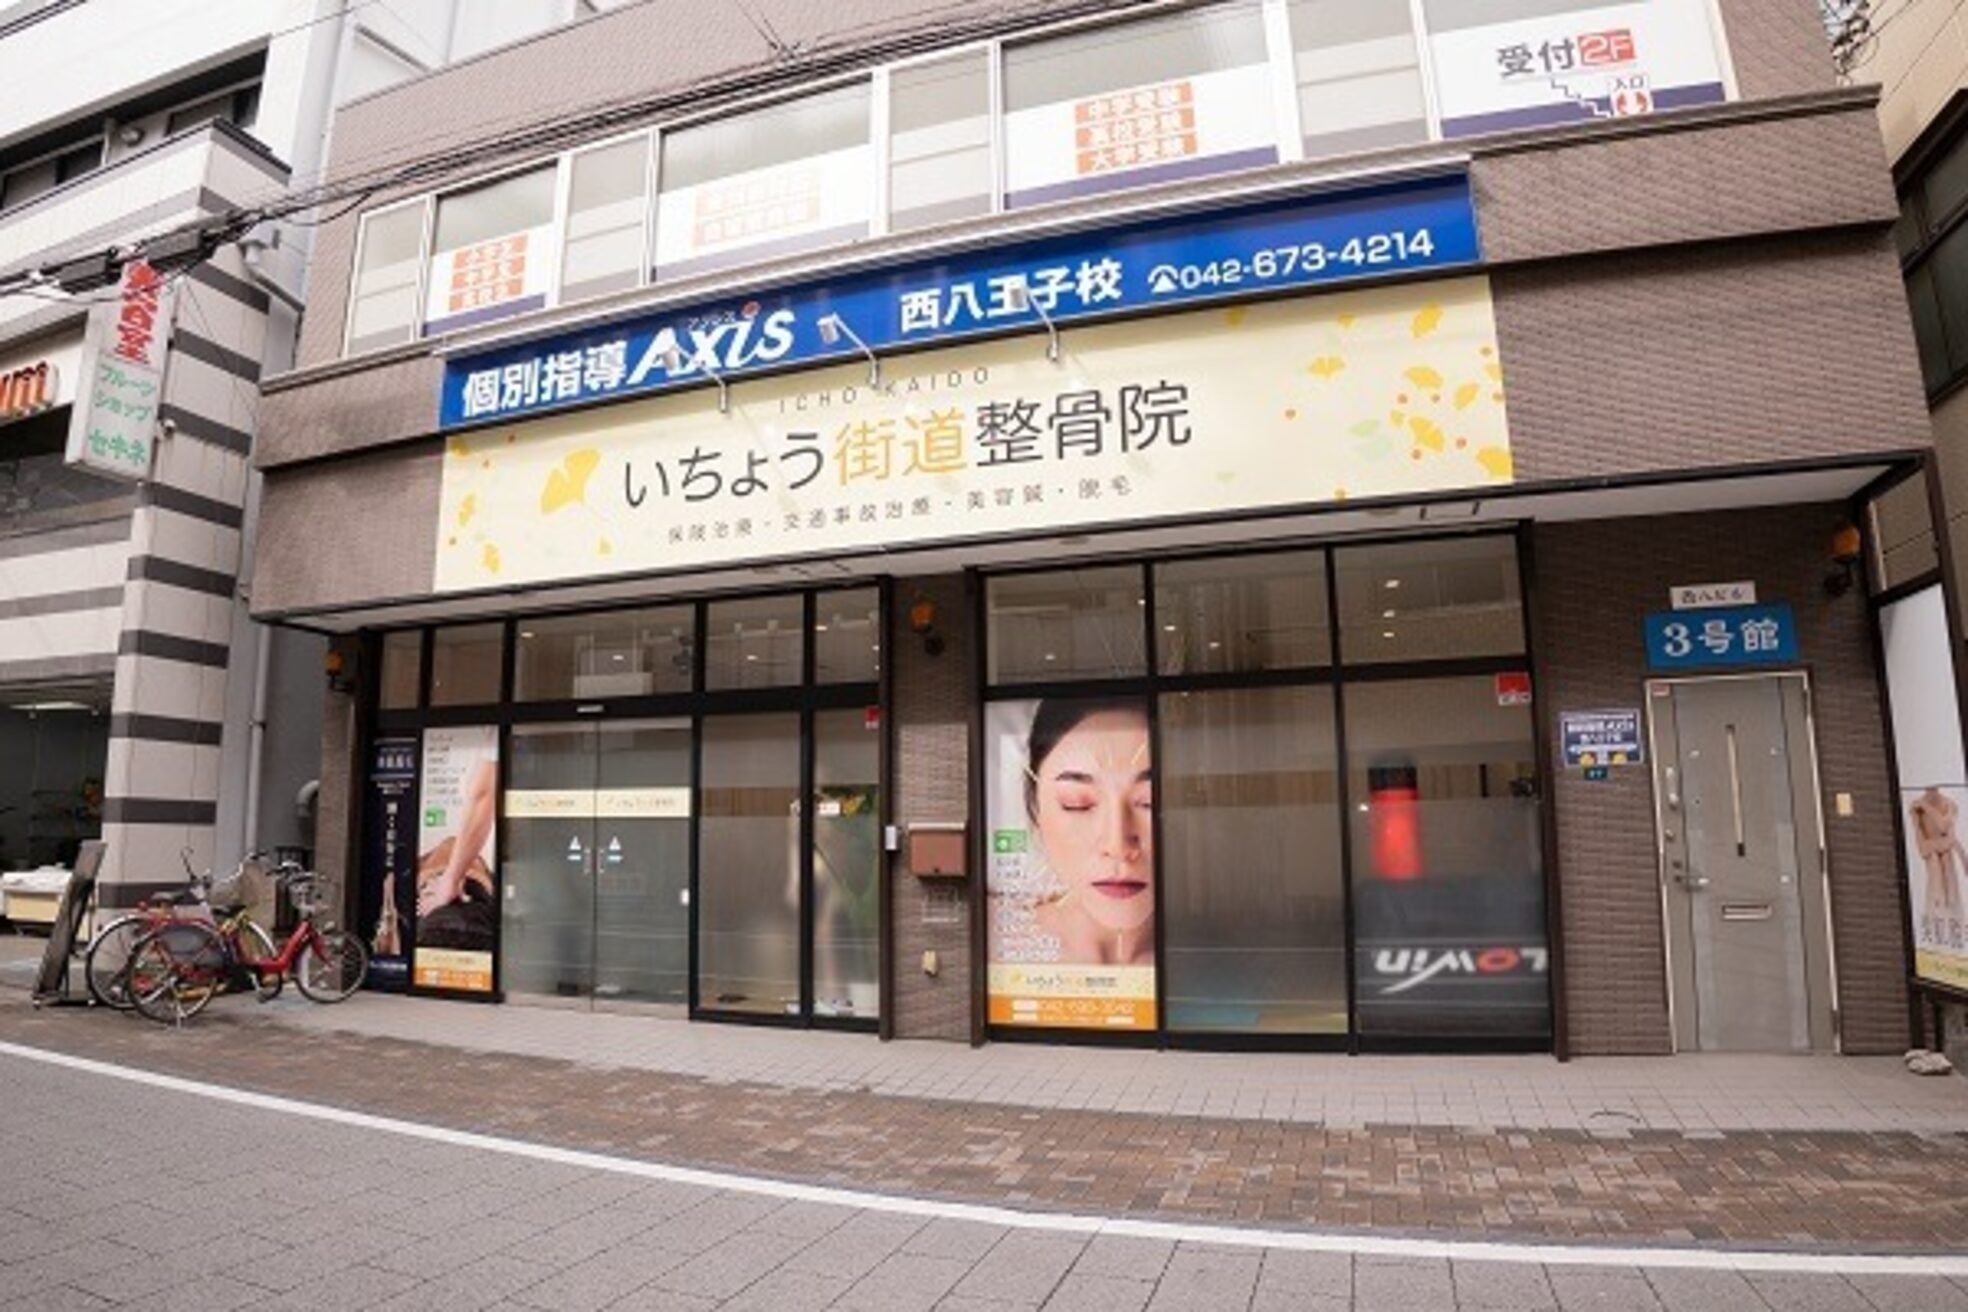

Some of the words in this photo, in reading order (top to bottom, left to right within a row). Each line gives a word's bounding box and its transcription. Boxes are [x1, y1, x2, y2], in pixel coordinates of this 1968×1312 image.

[1498, 37, 1575, 77] 受付
[1181, 228, 1435, 290] 042-673-4214
[462, 340, 628, 418] 個別指導
[900, 257, 1123, 333] 西八王子校
[779, 386, 857, 414] ICHO
[884, 366, 989, 397] KAIDO
[623, 380, 1193, 508] いちょう街道整骨院
[1662, 617, 1780, 657] 3号館
